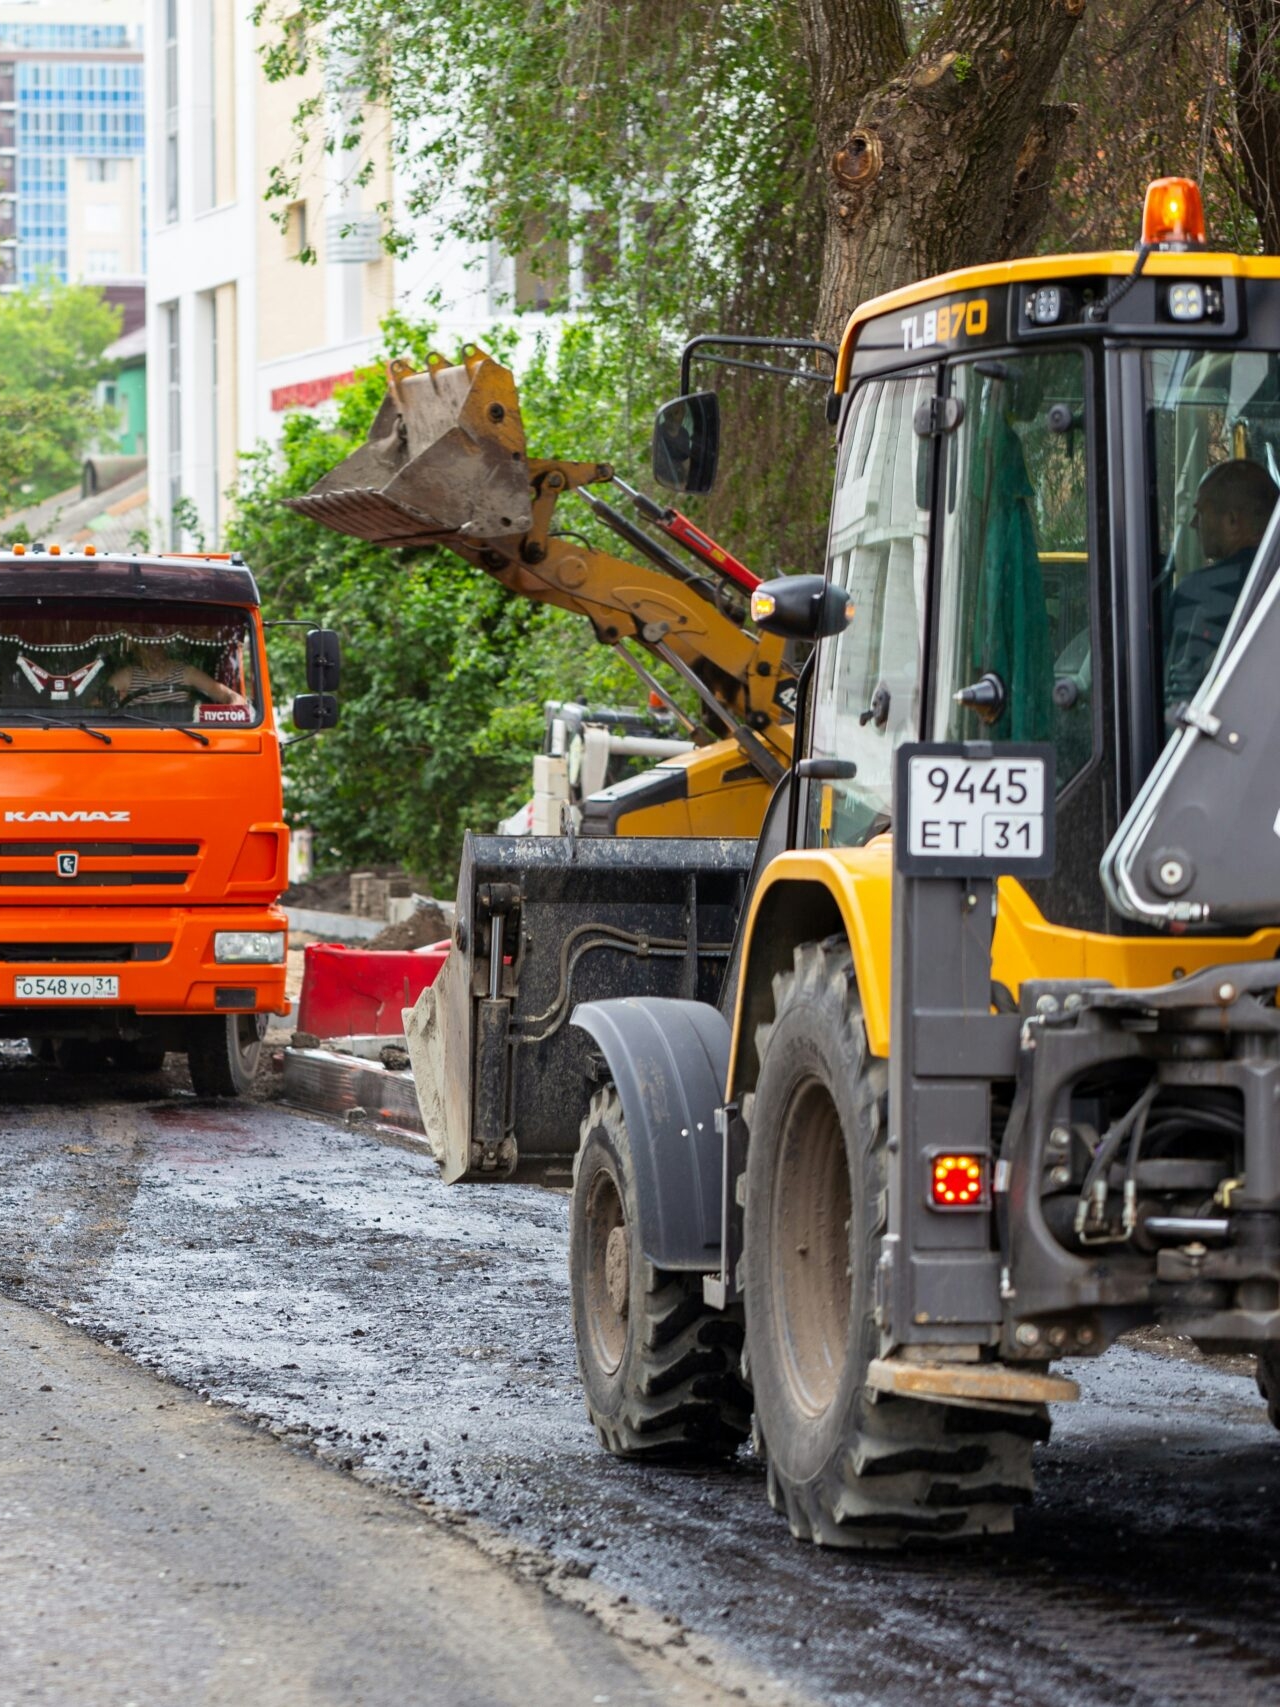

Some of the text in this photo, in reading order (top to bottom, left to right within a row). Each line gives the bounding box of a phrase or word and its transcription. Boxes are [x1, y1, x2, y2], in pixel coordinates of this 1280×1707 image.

[901, 299, 988, 352] TLB870
[204, 709, 245, 721] ПУСТОЙ
[927, 767, 1028, 804] 9445
[4, 811, 131, 822] KAMAZ
[994, 821, 1030, 850] 31
[96, 978, 112, 991] 31
